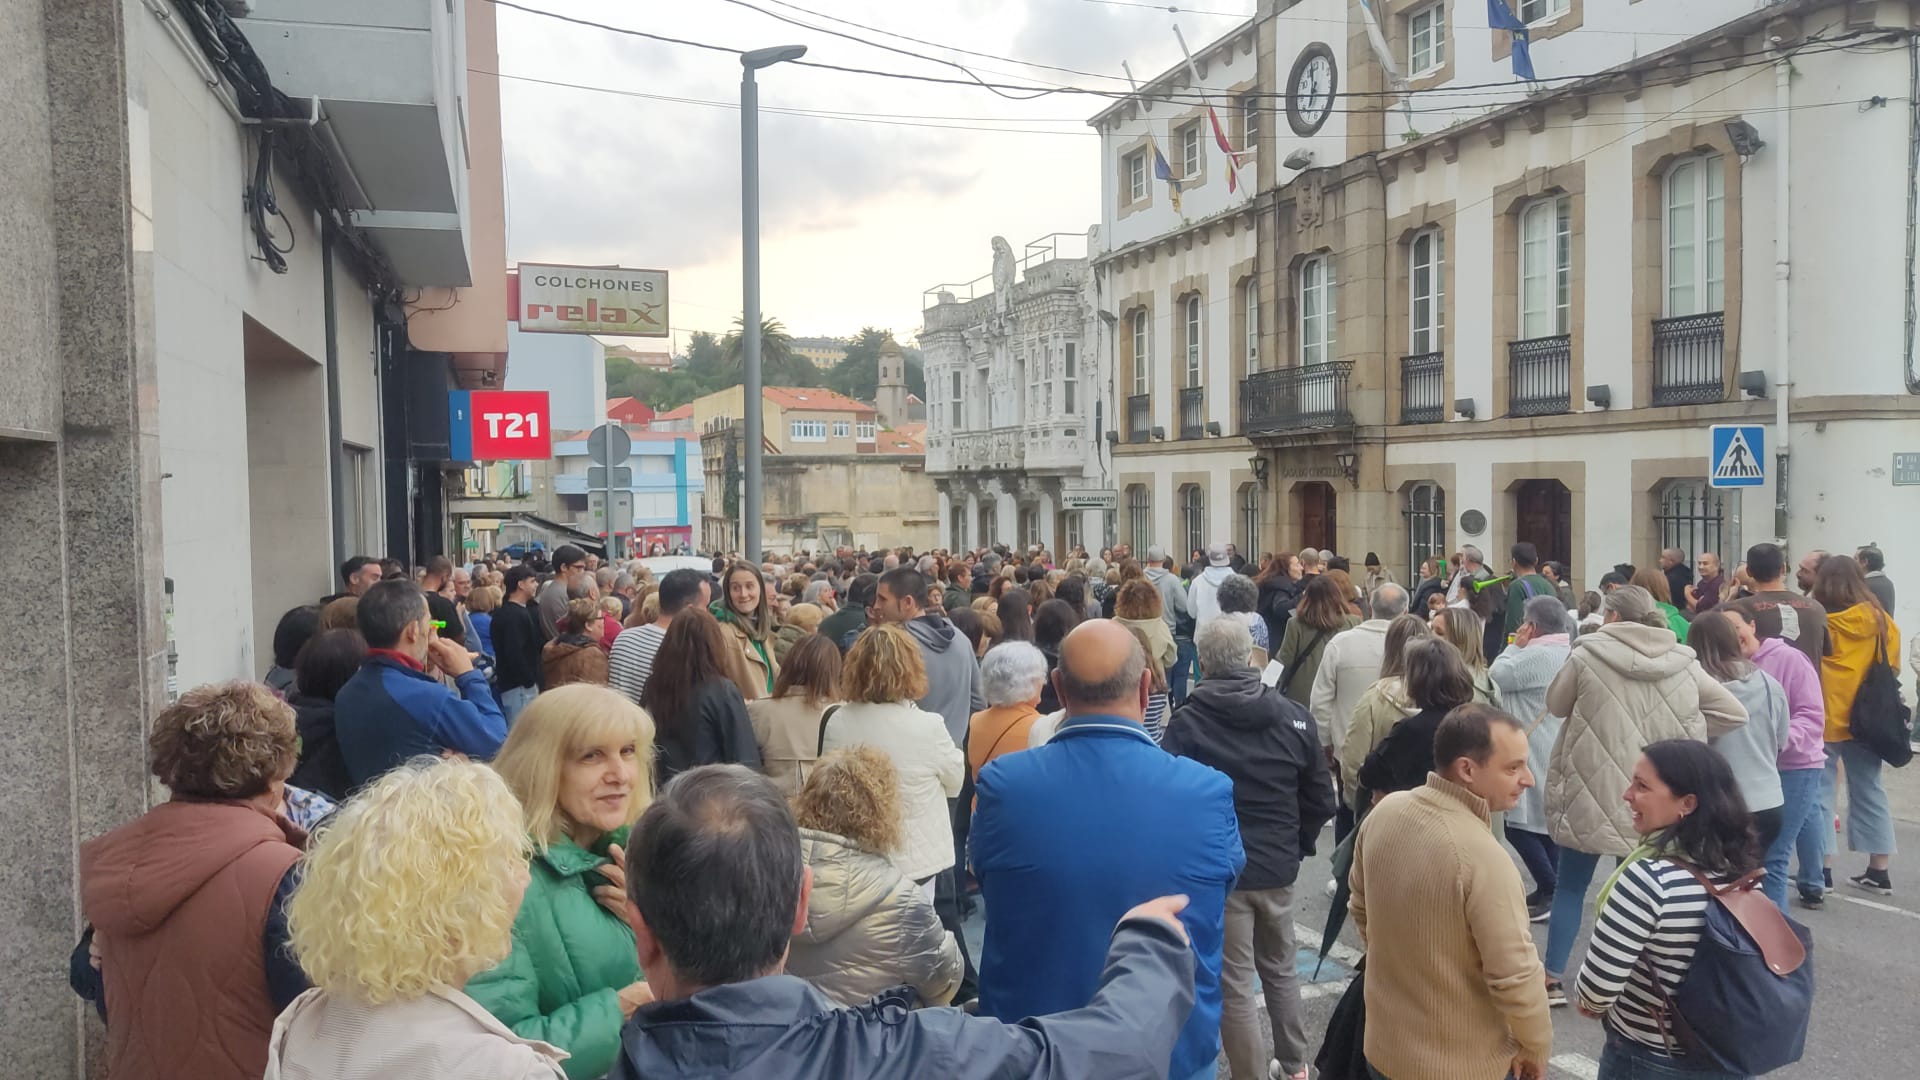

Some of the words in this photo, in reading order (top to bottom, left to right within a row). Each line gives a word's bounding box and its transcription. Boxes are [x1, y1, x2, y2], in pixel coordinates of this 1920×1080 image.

[534, 275, 654, 292] COLCHONES
[527, 298, 661, 325] relax
[483, 412, 539, 438] T21
